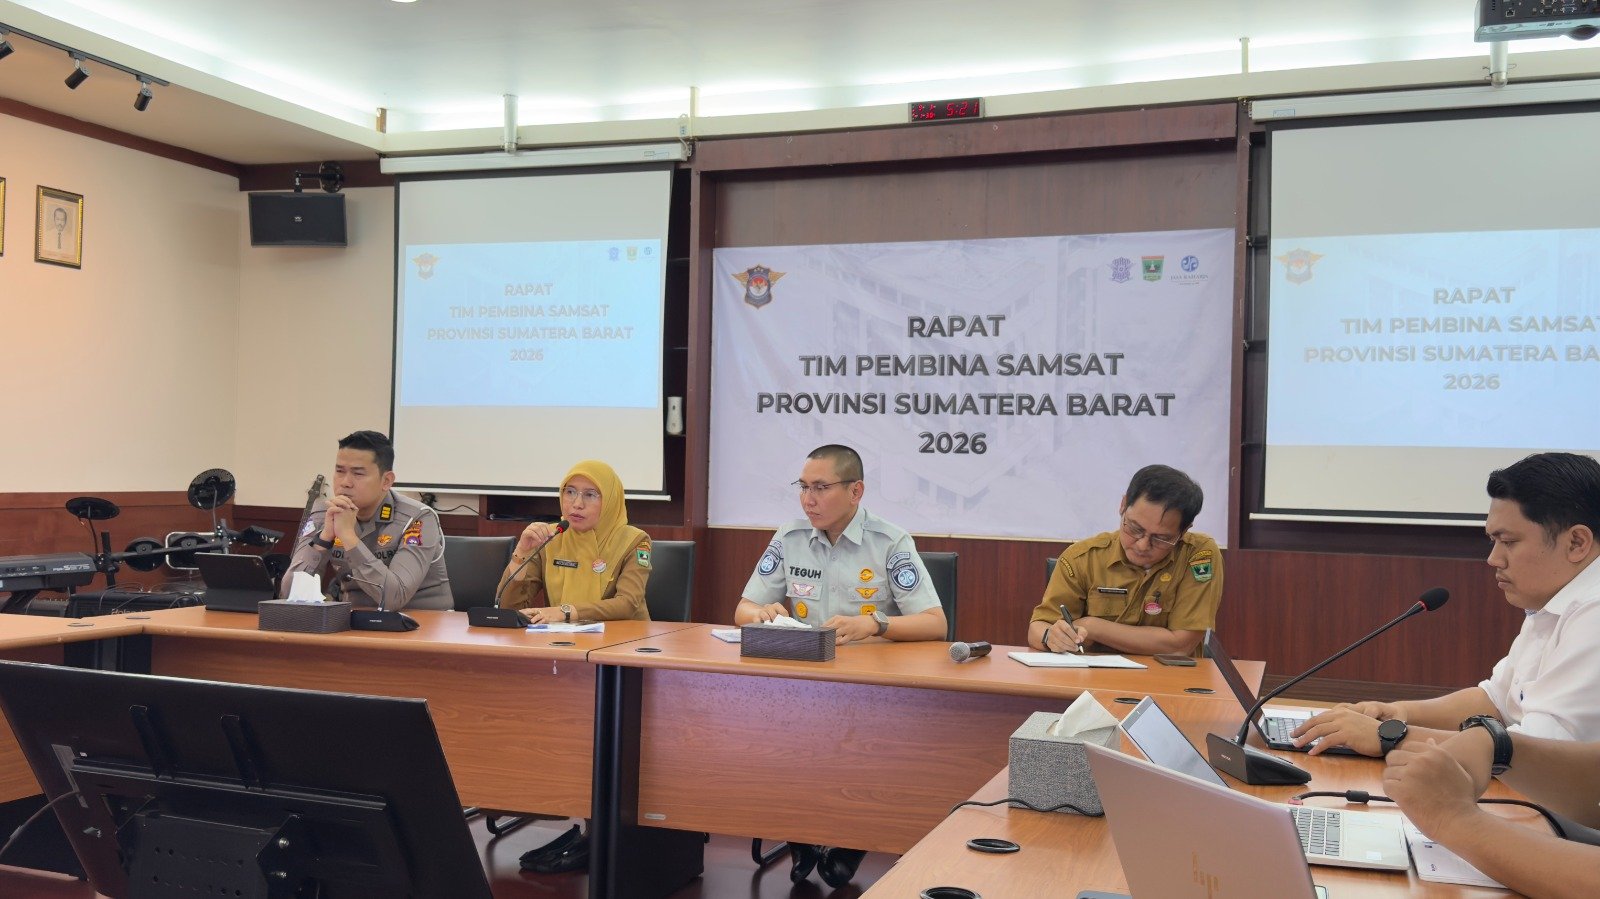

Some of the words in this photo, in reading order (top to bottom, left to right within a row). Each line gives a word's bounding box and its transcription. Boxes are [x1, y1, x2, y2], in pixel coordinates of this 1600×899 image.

[504, 283, 553, 297] RAPAT
[1433, 286, 1516, 305] RAPAT
[449, 305, 475, 319] TIM
[478, 304, 545, 319] PEMBINA
[548, 304, 610, 318] SAMSAT
[427, 326, 494, 341] PROVINSI
[497, 326, 577, 341] SUMATERA
[582, 326, 634, 340] BARAT
[907, 314, 1006, 338] RAPAT
[1340, 317, 1383, 334] TIM
[1389, 315, 1502, 333] PEMBINA
[510, 348, 544, 362] 2026
[1303, 345, 1416, 363] PROVINSI
[1422, 344, 1557, 362] SUMATERA
[798, 354, 847, 377] TIM
[855, 353, 990, 377] PEMBINA
[996, 352, 1125, 377] SAMSAT
[1443, 373, 1501, 390] 2026
[756, 392, 886, 415] PROVINSI
[893, 392, 1058, 416] SUMATERA
[1066, 392, 1176, 417] BARAT
[918, 431, 988, 455] 2026
[789, 565, 822, 580] TEGUH
